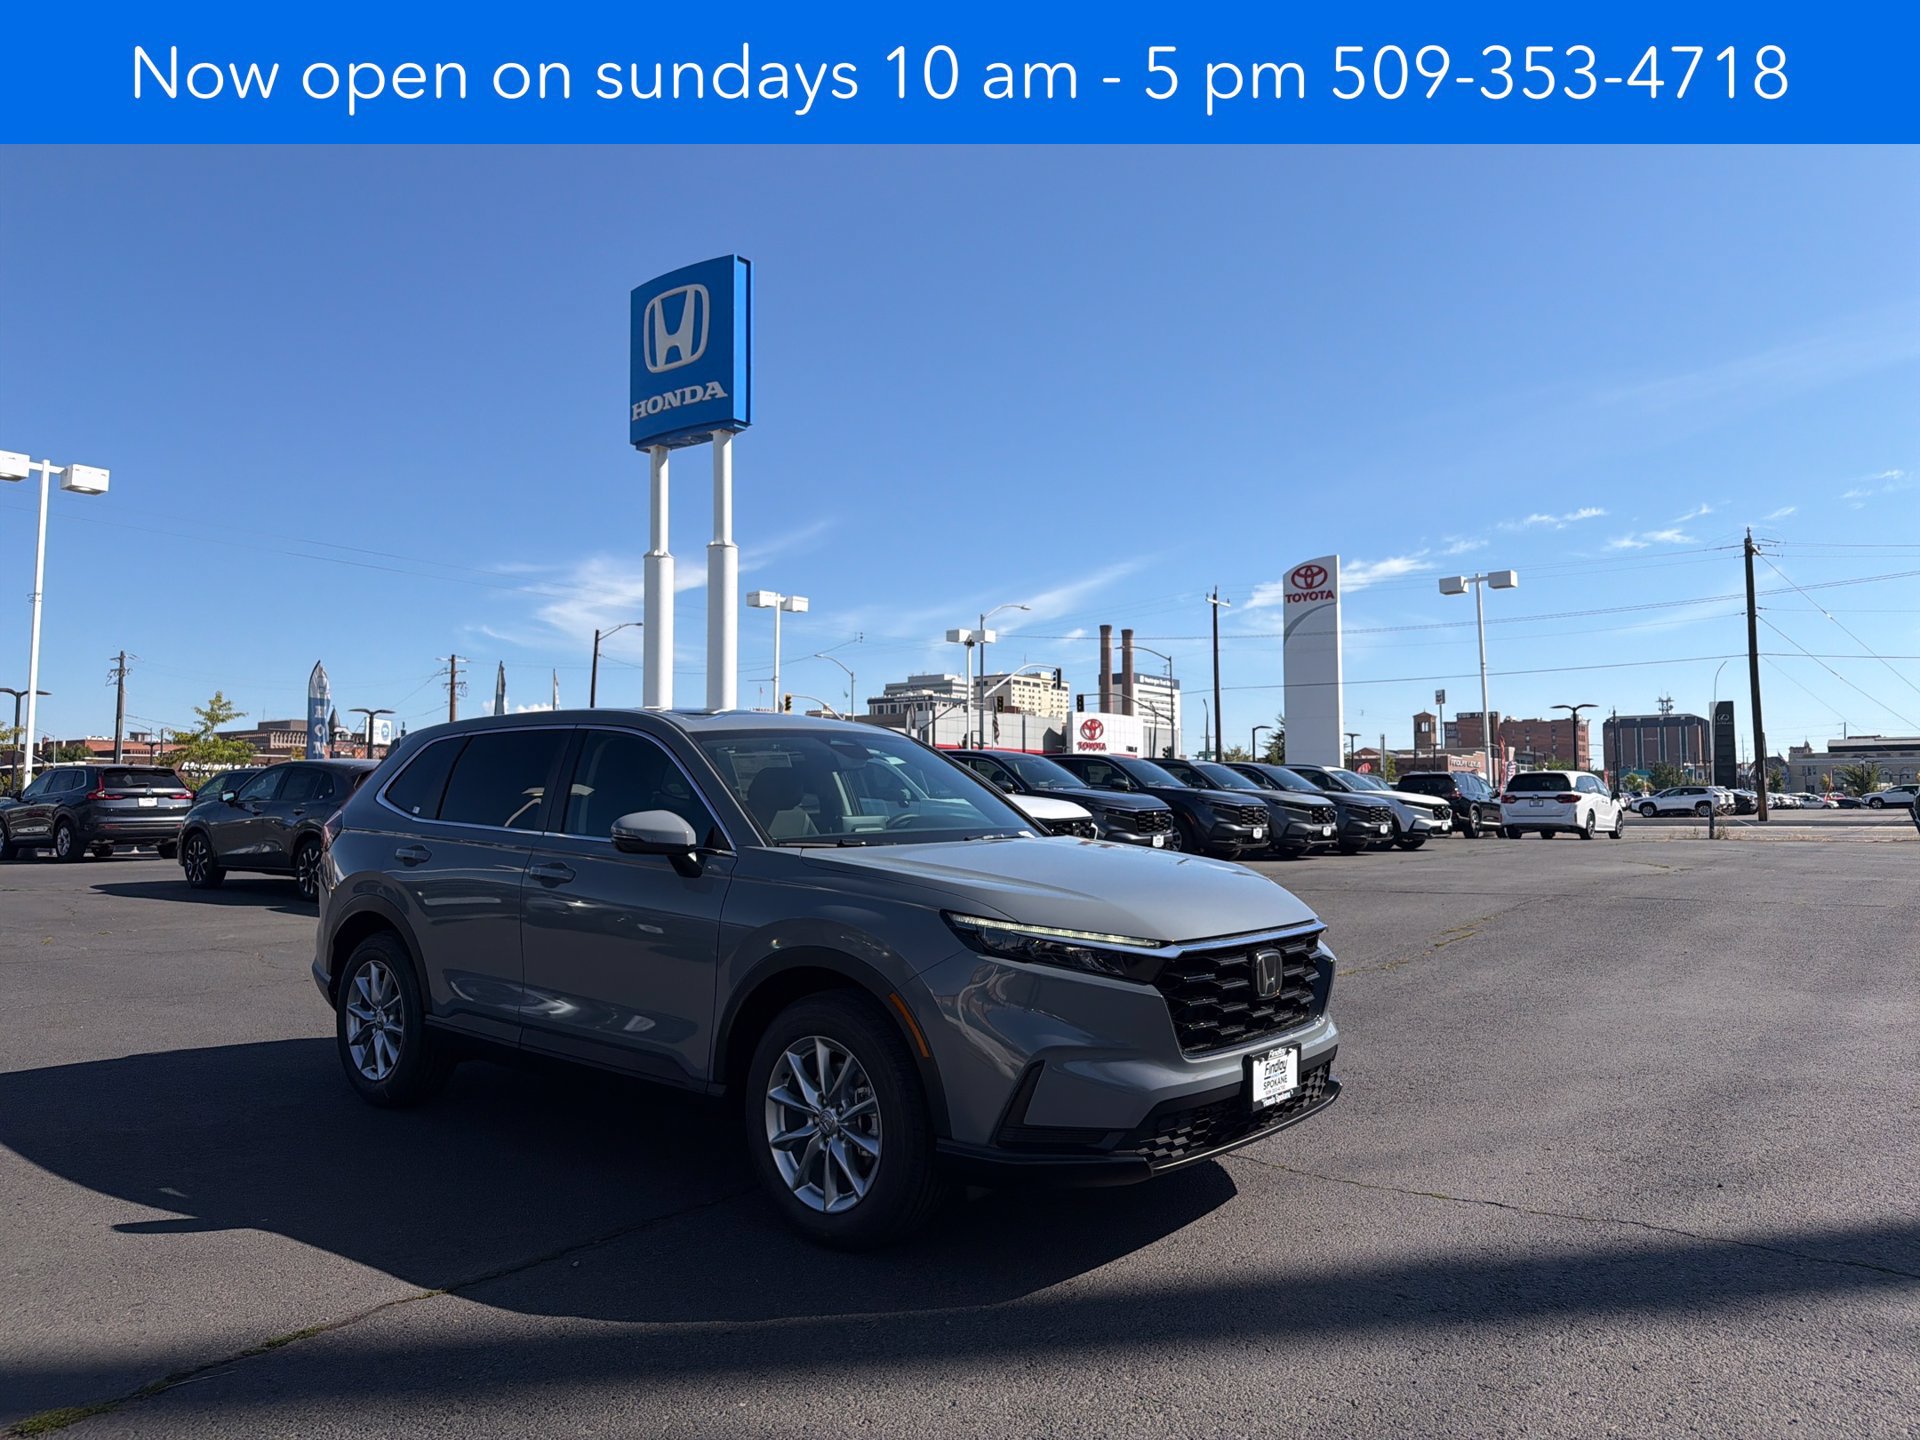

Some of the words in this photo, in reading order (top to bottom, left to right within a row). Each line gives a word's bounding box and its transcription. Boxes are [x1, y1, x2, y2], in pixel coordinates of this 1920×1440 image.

[631, 380, 728, 421] HONDA
[1285, 589, 1335, 604] TOYOTA
[1077, 742, 1107, 752] TOYOTA
[1264, 1059, 1288, 1076] Findlay
[1263, 1074, 1288, 1090] SPOKANE
